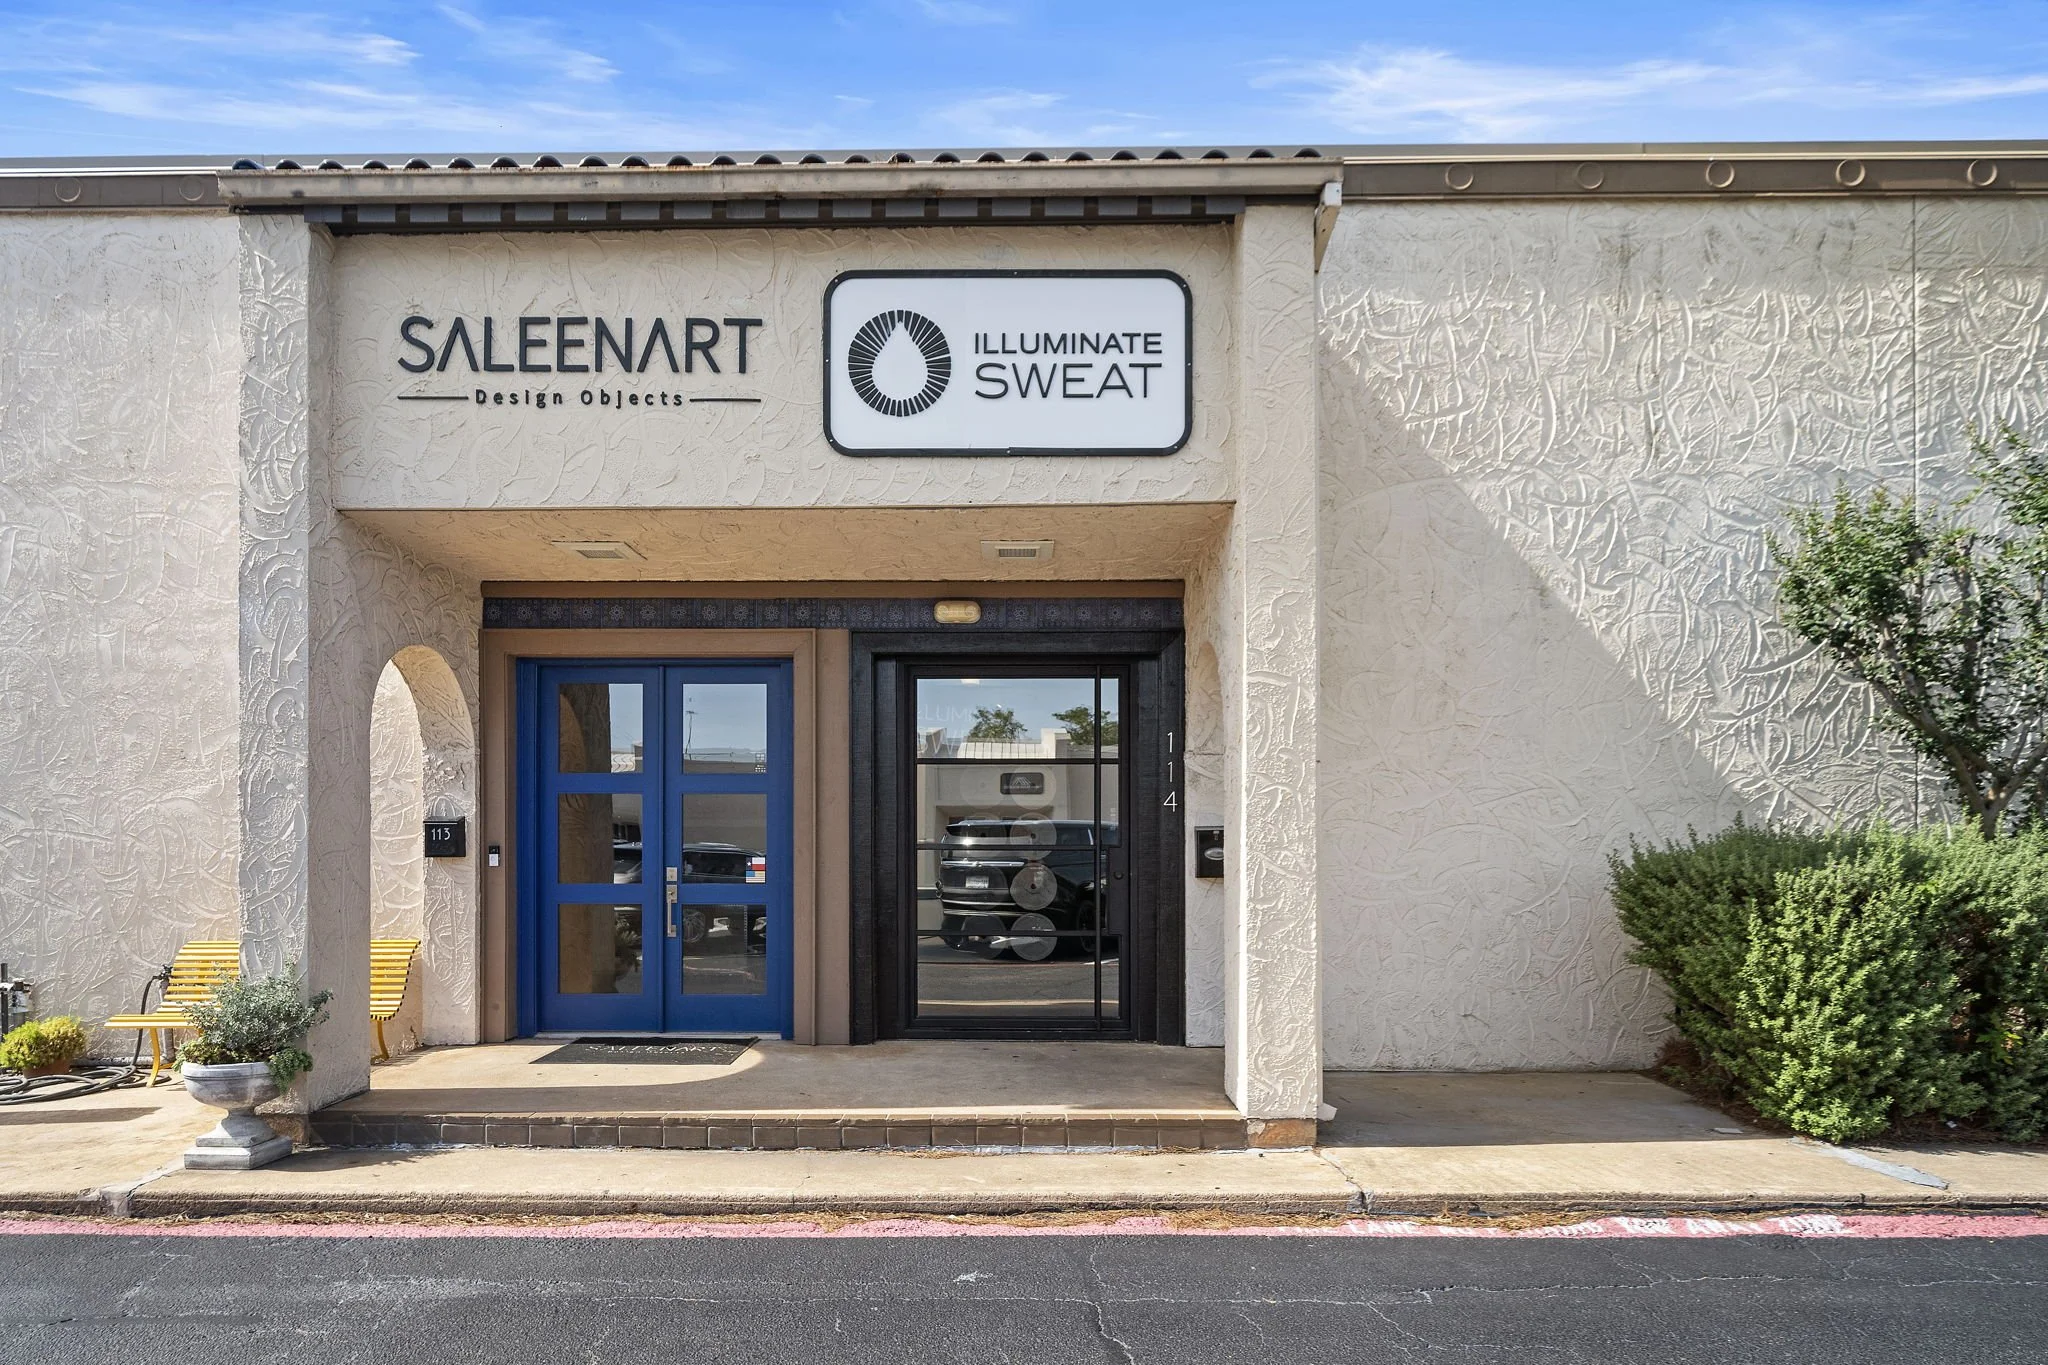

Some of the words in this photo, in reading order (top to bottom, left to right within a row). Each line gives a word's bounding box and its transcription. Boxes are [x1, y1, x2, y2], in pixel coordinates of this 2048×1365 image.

[397, 315, 763, 374] SALEENART
[974, 332, 1163, 354] ILLUMINATE
[974, 362, 1163, 399] SWEAT
[475, 388, 563, 409] Design
[580, 388, 683, 409] Objects
[431, 827, 451, 841] 113
